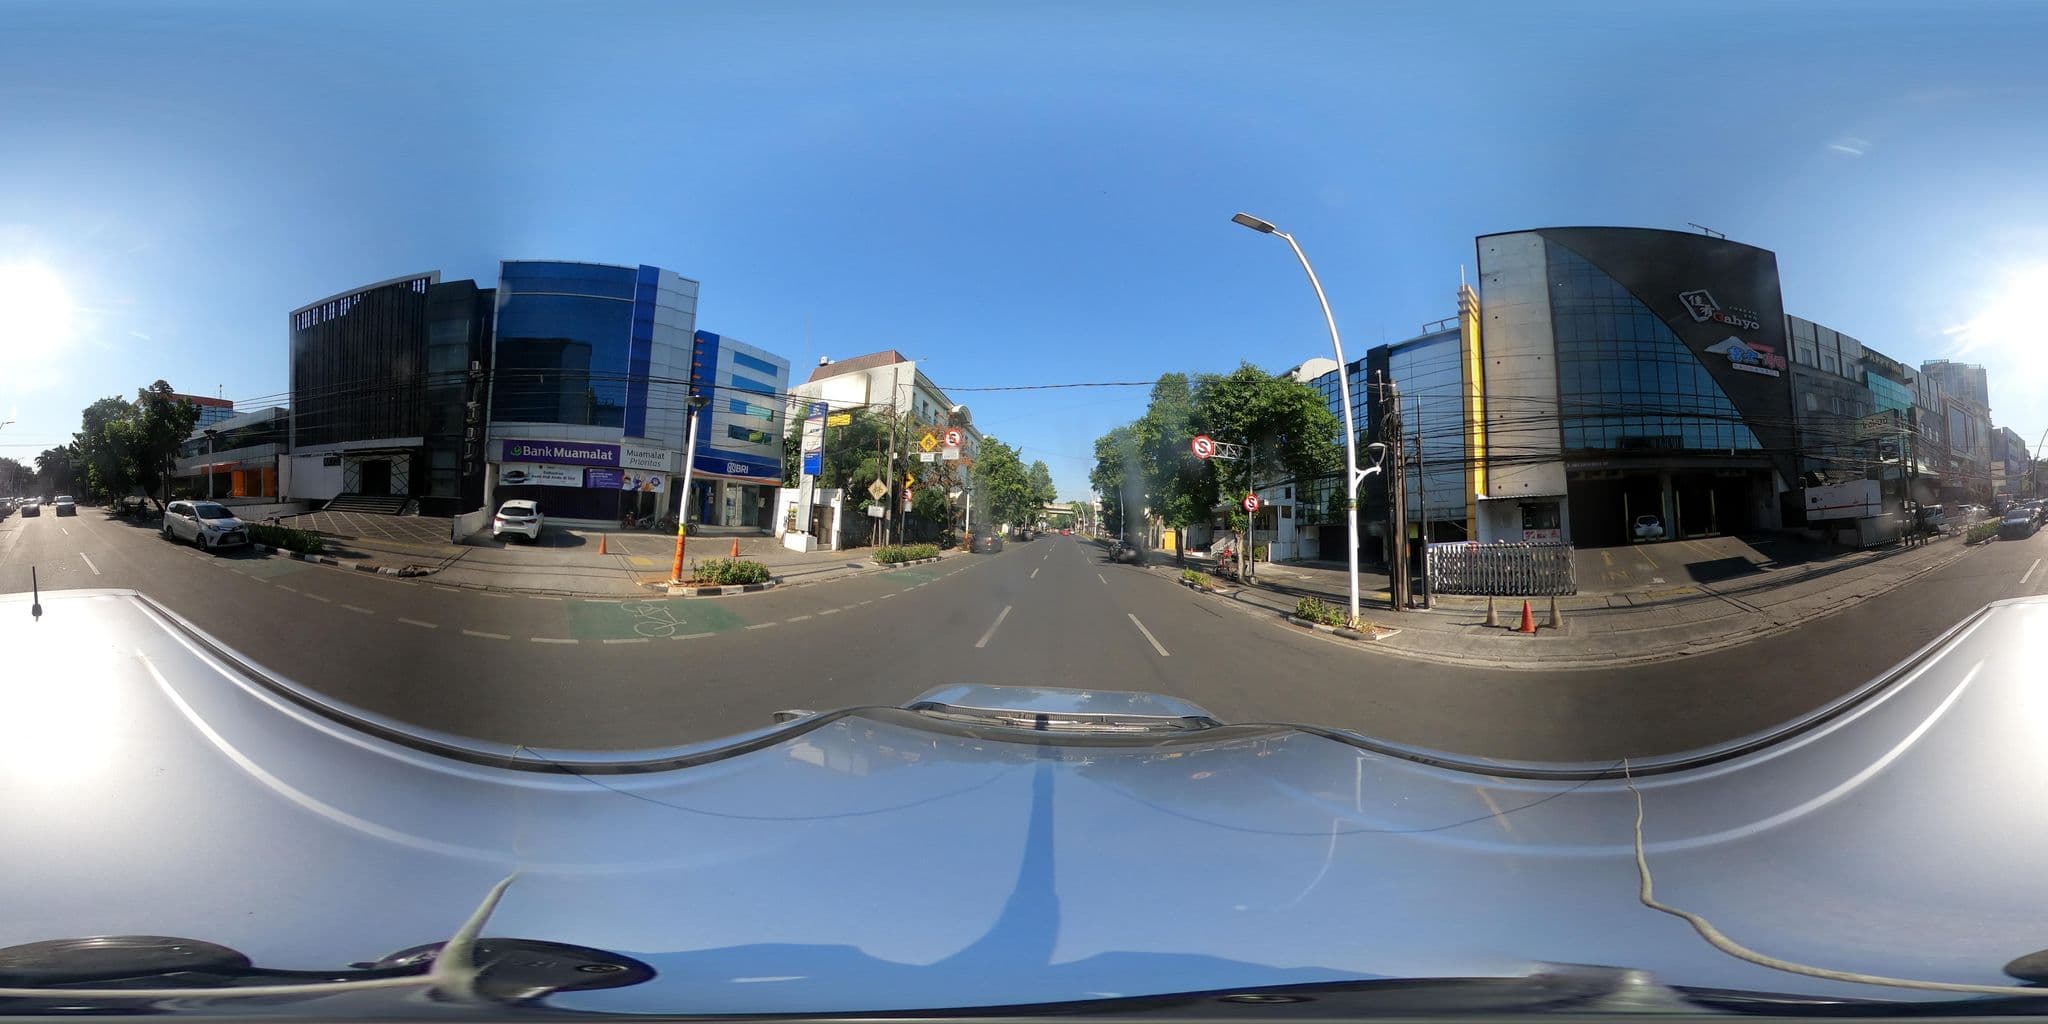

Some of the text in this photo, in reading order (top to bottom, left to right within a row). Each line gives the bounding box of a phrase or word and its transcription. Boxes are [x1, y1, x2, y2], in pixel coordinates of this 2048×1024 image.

[523, 445, 613, 461] Bank Muamalat
[626, 449, 665, 460] Muamalat
[630, 458, 662, 468] Prioritas
[736, 464, 749, 474] BRI
